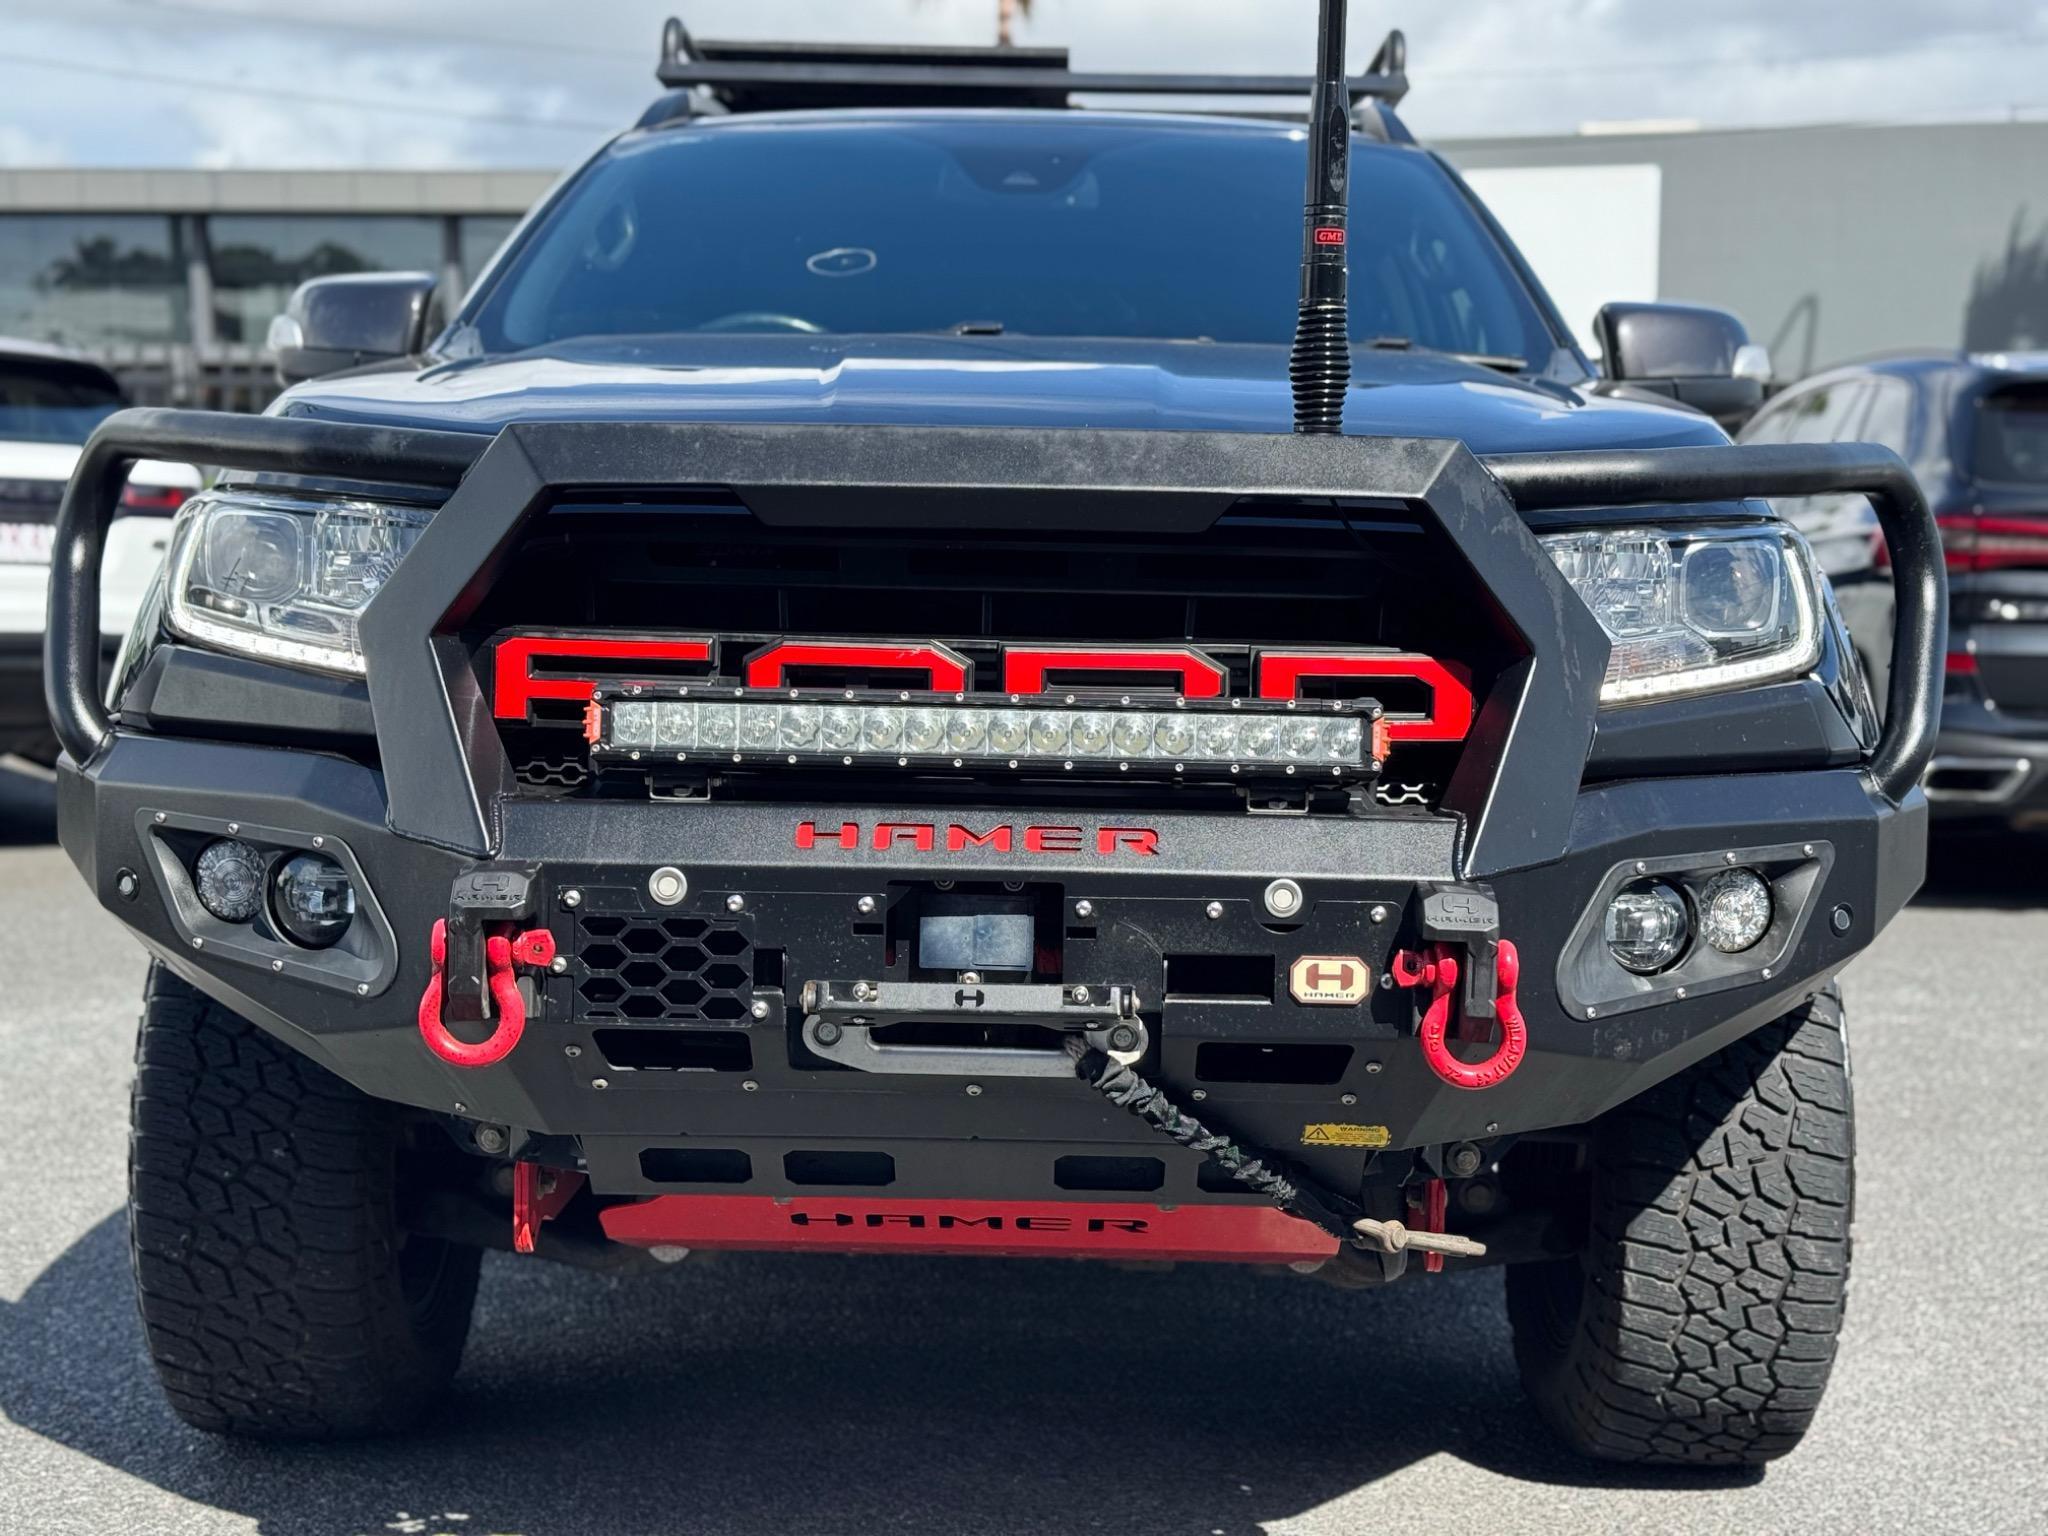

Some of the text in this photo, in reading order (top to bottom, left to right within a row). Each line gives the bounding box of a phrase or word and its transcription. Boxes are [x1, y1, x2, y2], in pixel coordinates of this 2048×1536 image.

[494, 635, 1474, 742] FORD
[795, 821, 1160, 856] HAMER
[790, 1213, 1150, 1234] HAMER
